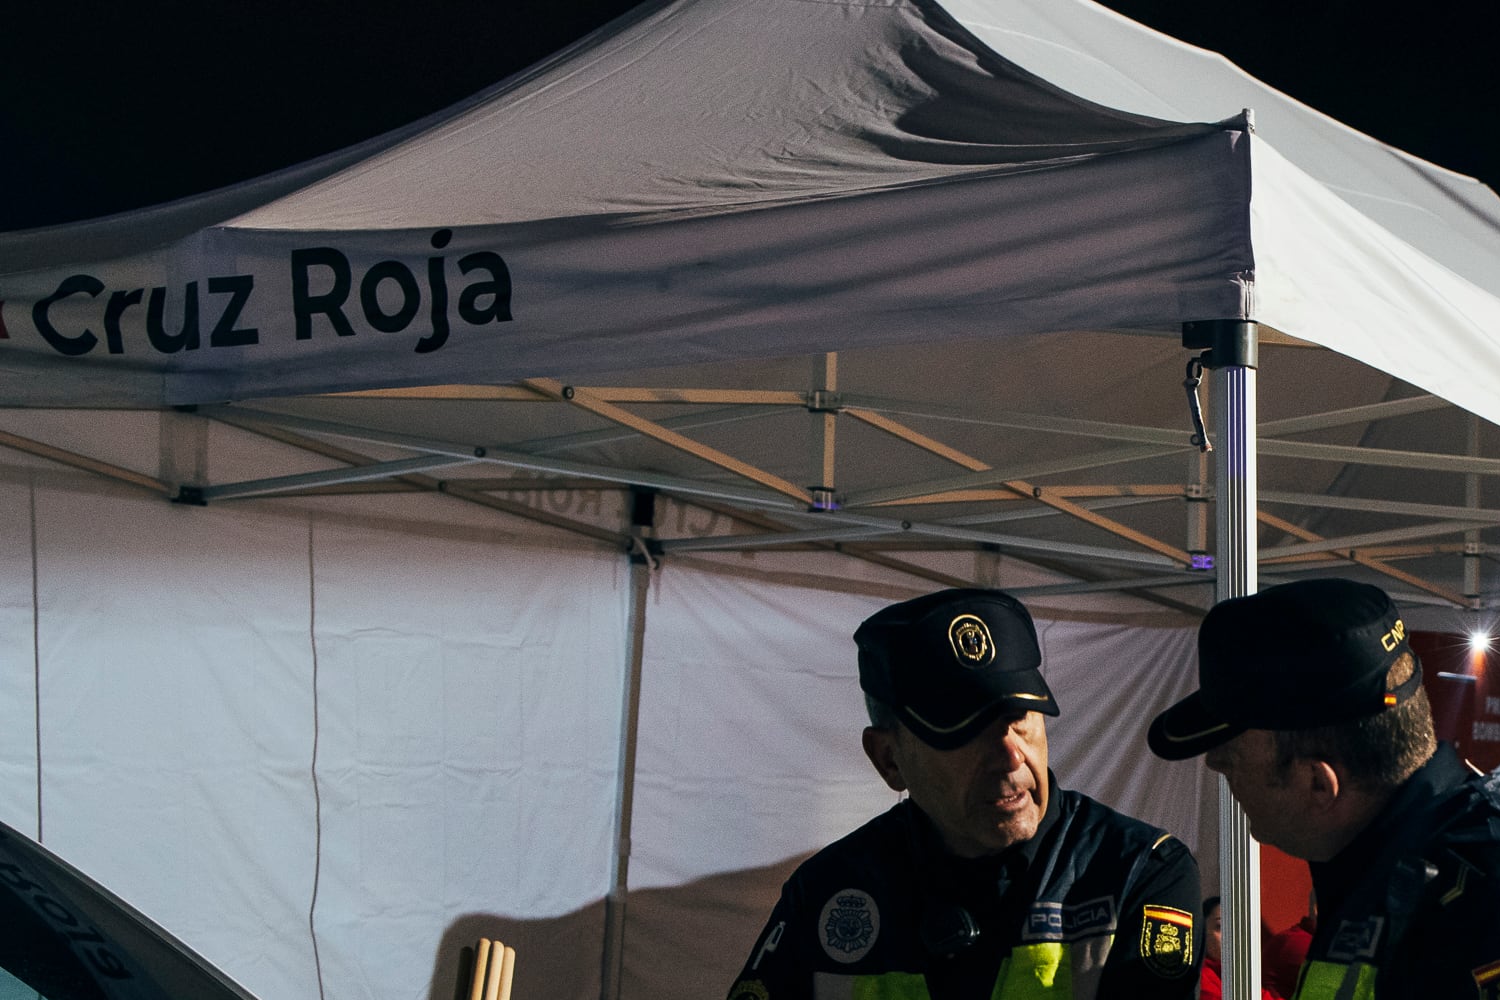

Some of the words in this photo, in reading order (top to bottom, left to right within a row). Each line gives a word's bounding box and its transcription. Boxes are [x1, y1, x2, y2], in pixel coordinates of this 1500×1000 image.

[32, 274, 259, 356] Cruz
[292, 228, 514, 354] Roja
[1030, 906, 1110, 928] POLICIA
